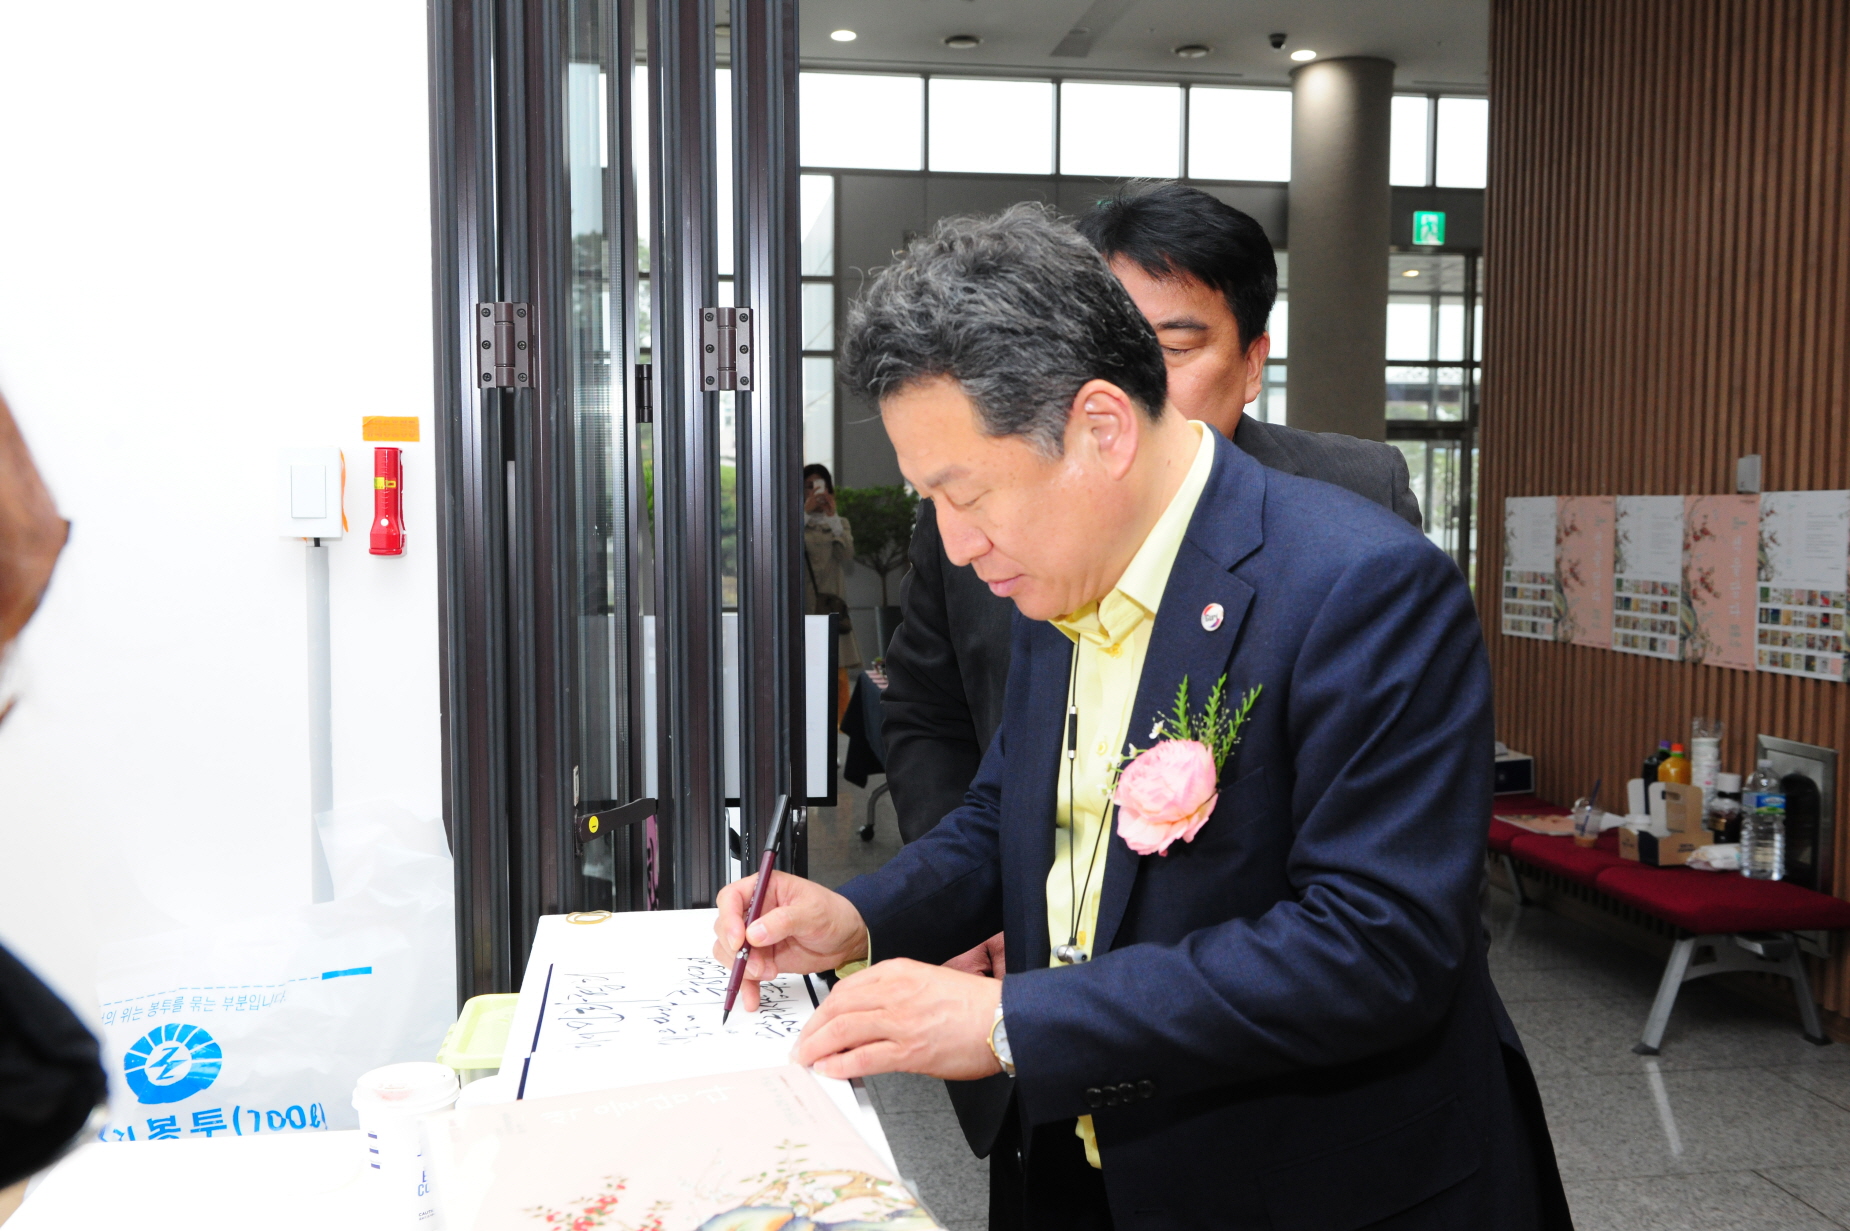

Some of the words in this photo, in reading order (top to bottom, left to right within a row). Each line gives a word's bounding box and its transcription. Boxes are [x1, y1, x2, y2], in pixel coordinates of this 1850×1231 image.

[120, 1006, 144, 1023] 위는
[147, 995, 185, 1018] 봉투를
[189, 996, 217, 1012] 묶는
